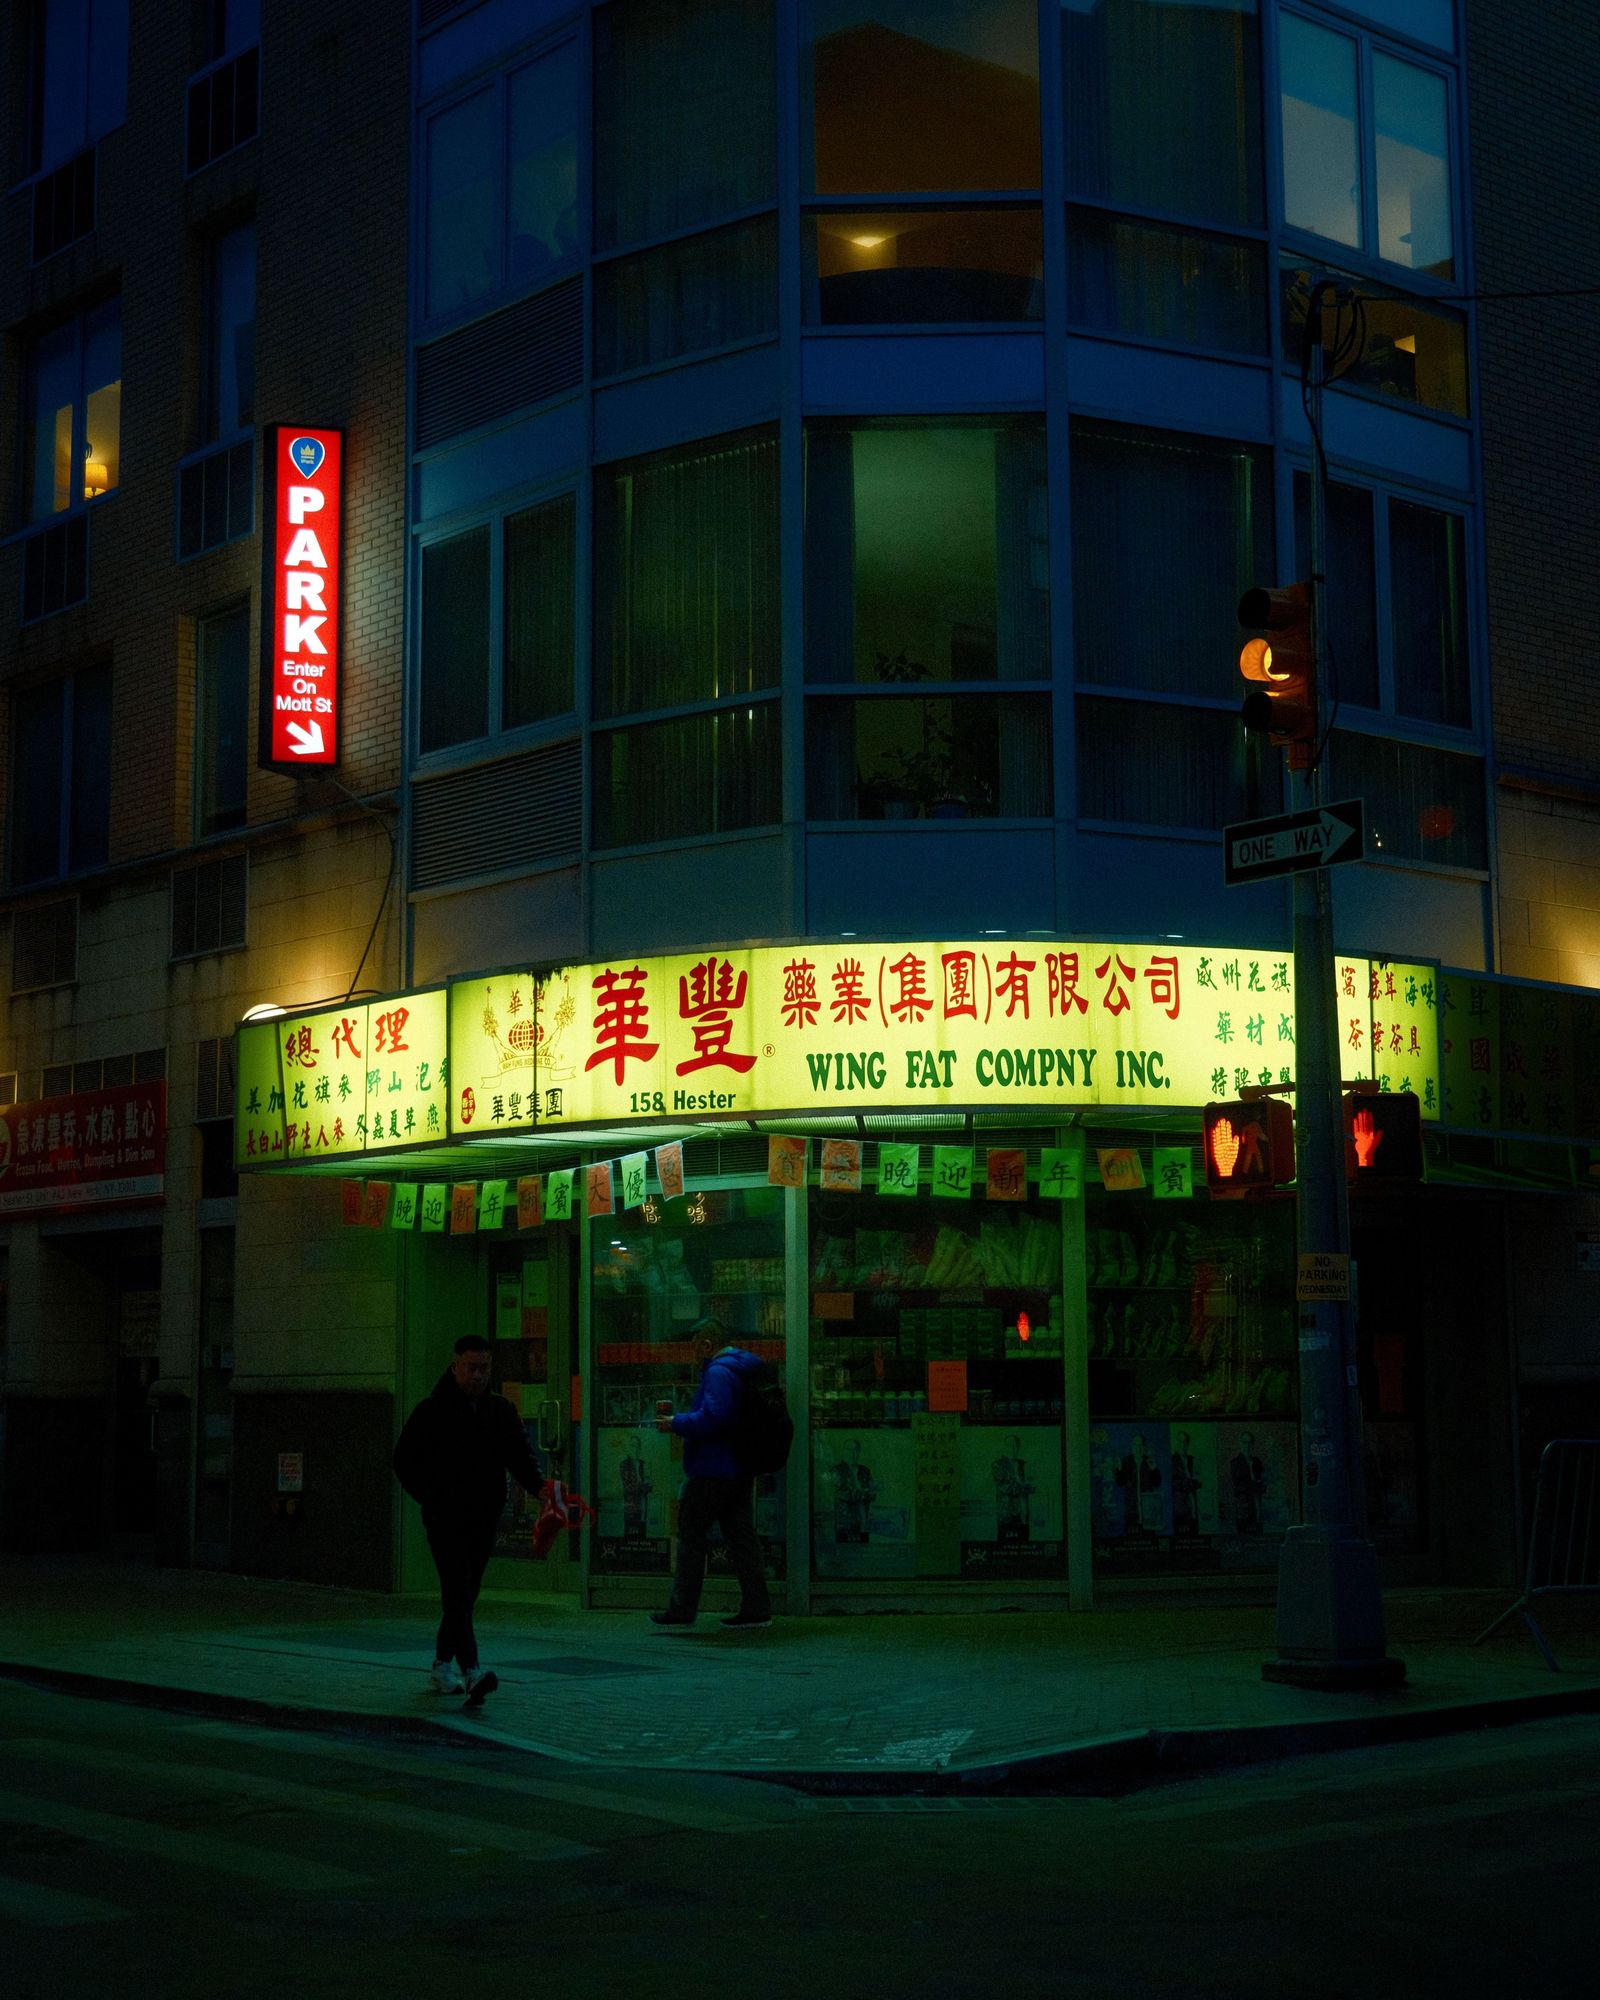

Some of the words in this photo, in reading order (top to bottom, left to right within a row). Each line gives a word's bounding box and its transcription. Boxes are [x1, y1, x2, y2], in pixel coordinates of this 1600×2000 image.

[284, 486, 328, 655] PARK
[283, 660, 326, 677] Enter
[293, 678, 317, 694] On
[276, 695, 312, 712] Mott
[314, 697, 332, 713] St
[1239, 836, 1274, 864] ONE
[1294, 824, 1334, 852] WAY
[285, 1007, 410, 1069] 總代理
[806, 1052, 886, 1091] WING
[906, 1050, 957, 1089] FAT
[976, 1049, 1097, 1088] COMPNY
[1115, 1050, 1170, 1089] INC.
[630, 1092, 664, 1113] 158
[673, 1090, 736, 1112] Hester
[1315, 1256, 1330, 1267] NO
[1299, 1269, 1346, 1281] PARKING
